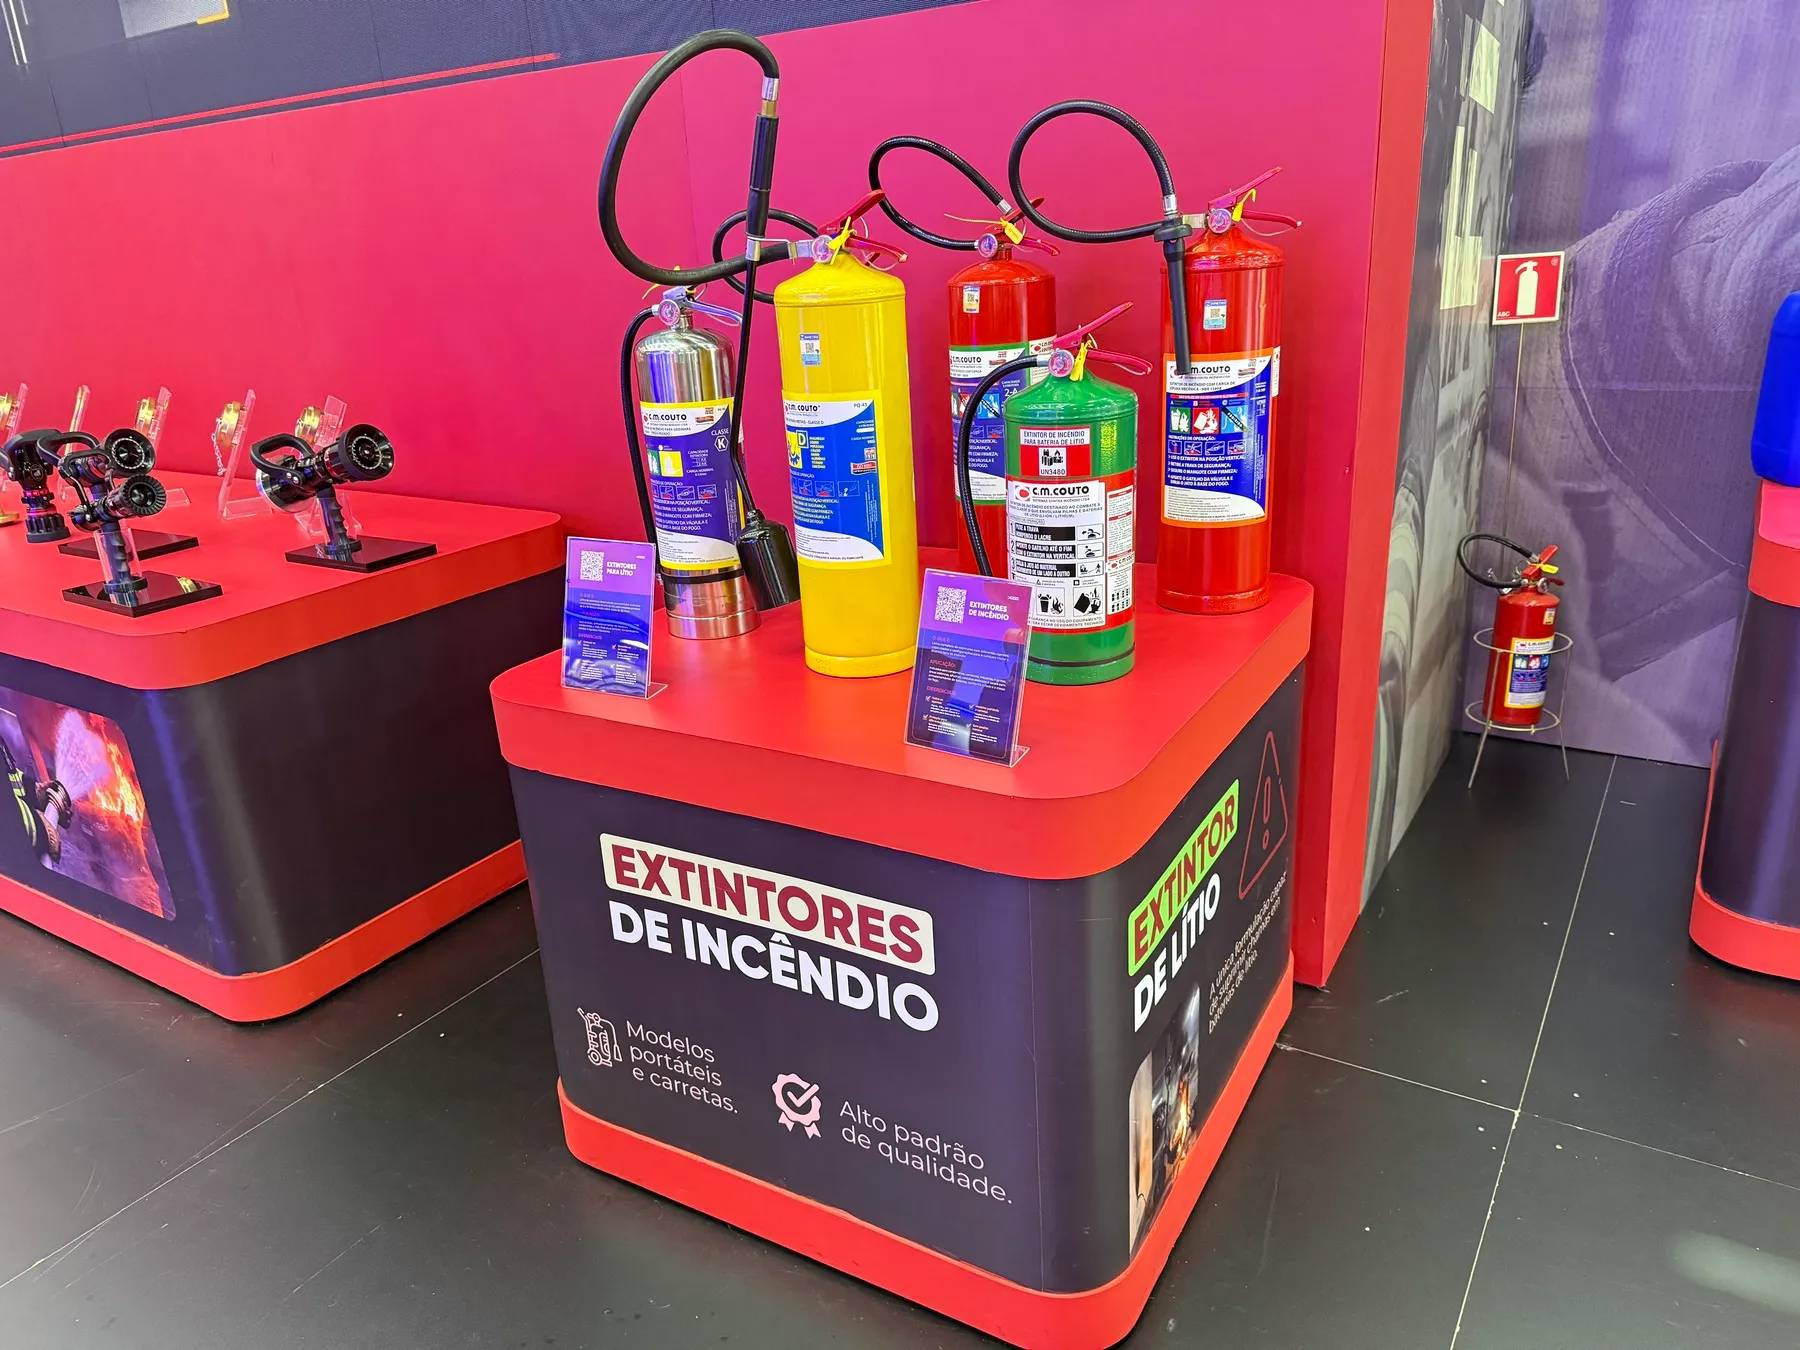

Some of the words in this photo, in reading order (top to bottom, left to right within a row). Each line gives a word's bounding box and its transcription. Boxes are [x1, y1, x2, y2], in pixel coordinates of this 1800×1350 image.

[717, 438, 725, 448] K
[797, 433, 806, 446] D
[1032, 486, 1089, 496] C.M.COUTO
[607, 561, 636, 569] EXTINTORES
[1011, 540, 1014, 552] 2
[970, 601, 1007, 612] EXTINTORES
[978, 610, 1009, 620] INCÊNDIO
[611, 844, 923, 964] EXTINTORES
[1134, 794, 1235, 966] EXTINTOR
[1134, 947, 1167, 1033] DE
[1172, 873, 1221, 979] LÍTIO
[1209, 996, 1218, 1016] de
[1219, 950, 1246, 1001] suprimir
[1247, 912, 1271, 953] chamas
[1270, 896, 1281, 917] em
[1210, 982, 1216, 1000] A
[1216, 953, 1234, 988] única
[1235, 898, 1270, 955] formulação
[1270, 871, 1287, 902] capaz
[609, 900, 672, 954] DE
[682, 918, 939, 1032] INCÊNDIO
[1209, 988, 1235, 1034] baterias
[1235, 968, 1244, 988] de
[1245, 950, 1258, 974] lítio.
[626, 1020, 715, 1063] Modelos
[630, 1045, 722, 1087] portáteis
[632, 1066, 644, 1081] e
[650, 1072, 738, 1114] carretas.
[840, 1100, 886, 1132] Alto
[894, 1124, 984, 1170] padrão
[842, 1125, 872, 1150] de
[878, 1141, 1012, 1204] qualidade.
